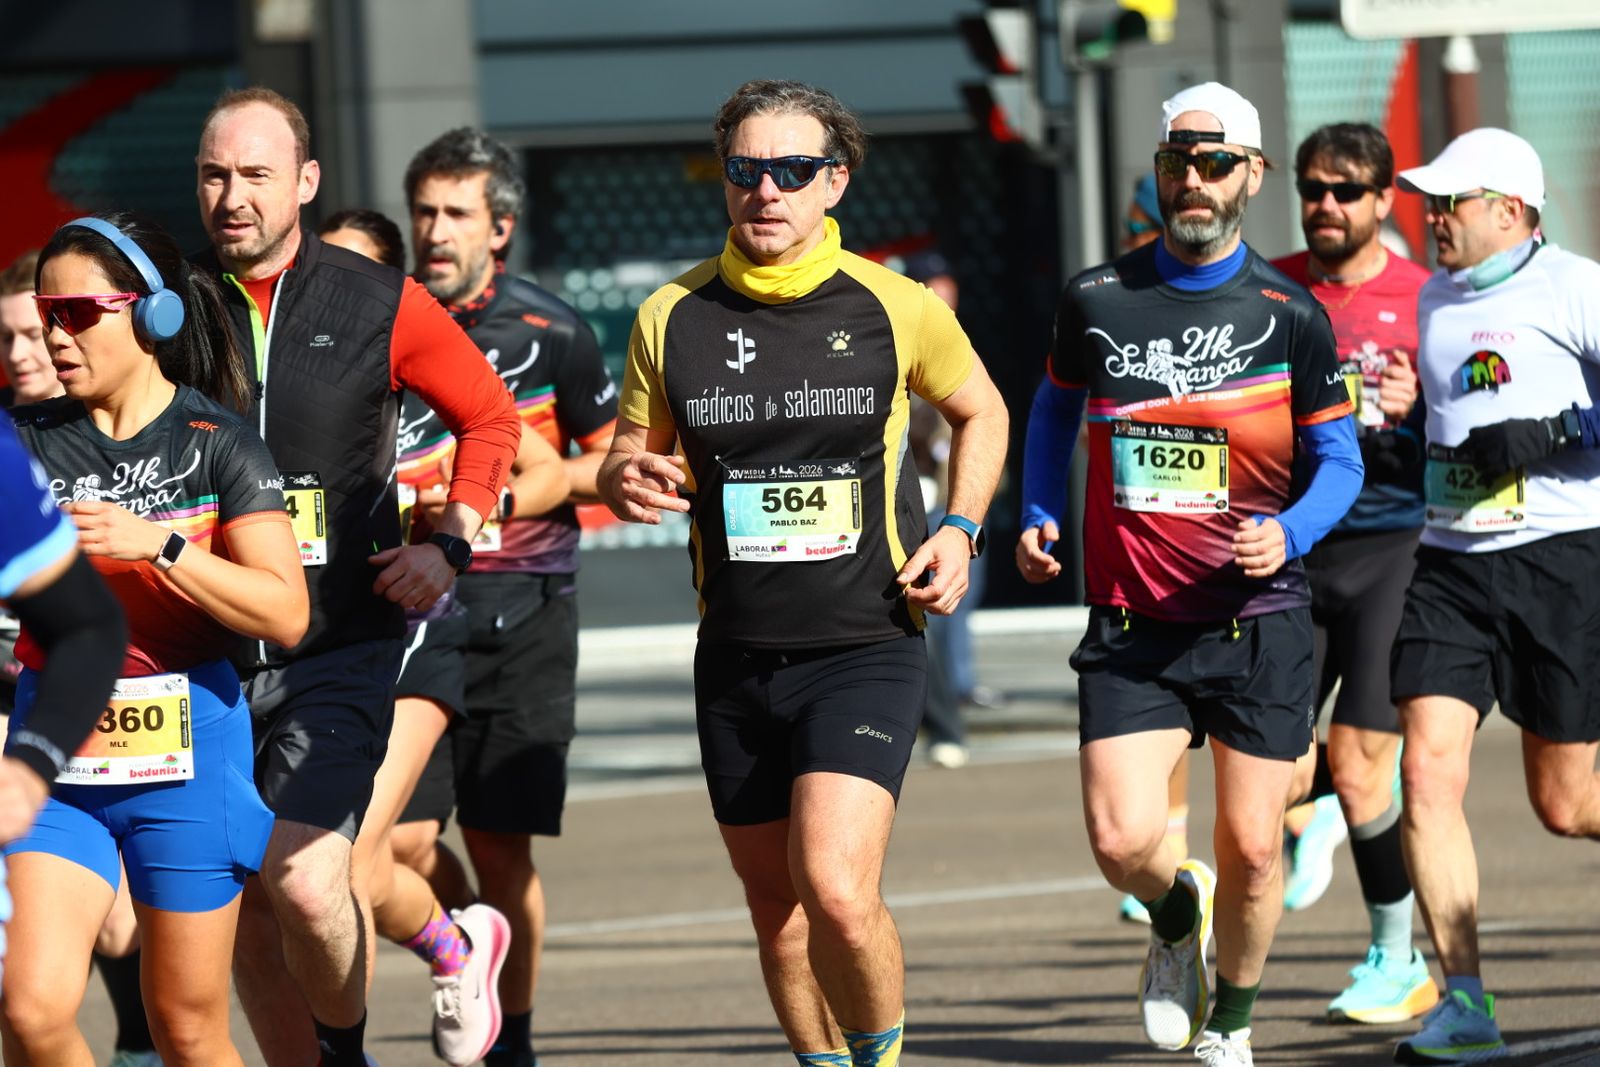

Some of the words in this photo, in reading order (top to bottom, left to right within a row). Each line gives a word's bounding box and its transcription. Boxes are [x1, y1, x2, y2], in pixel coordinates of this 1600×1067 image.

[1183, 323, 1245, 361] 21k
[1105, 343, 1253, 390] Salamanca
[686, 386, 755, 427] médicos
[765, 396, 778, 421] de
[784, 379, 875, 419] salamanca
[1132, 445, 1205, 471] 1620
[112, 456, 172, 494] 21k
[728, 469, 744, 480] XIV
[798, 465, 823, 475] 2026
[1153, 474, 1182, 482] CARLOS
[762, 486, 827, 513] 564
[770, 519, 798, 527] PABLO
[800, 518, 817, 526] BAZ
[735, 545, 770, 553] LABORAL
[805, 543, 846, 556] bedunia
[93, 705, 165, 733] 360
[867, 729, 893, 743] asics
[129, 767, 178, 778] bedunia
